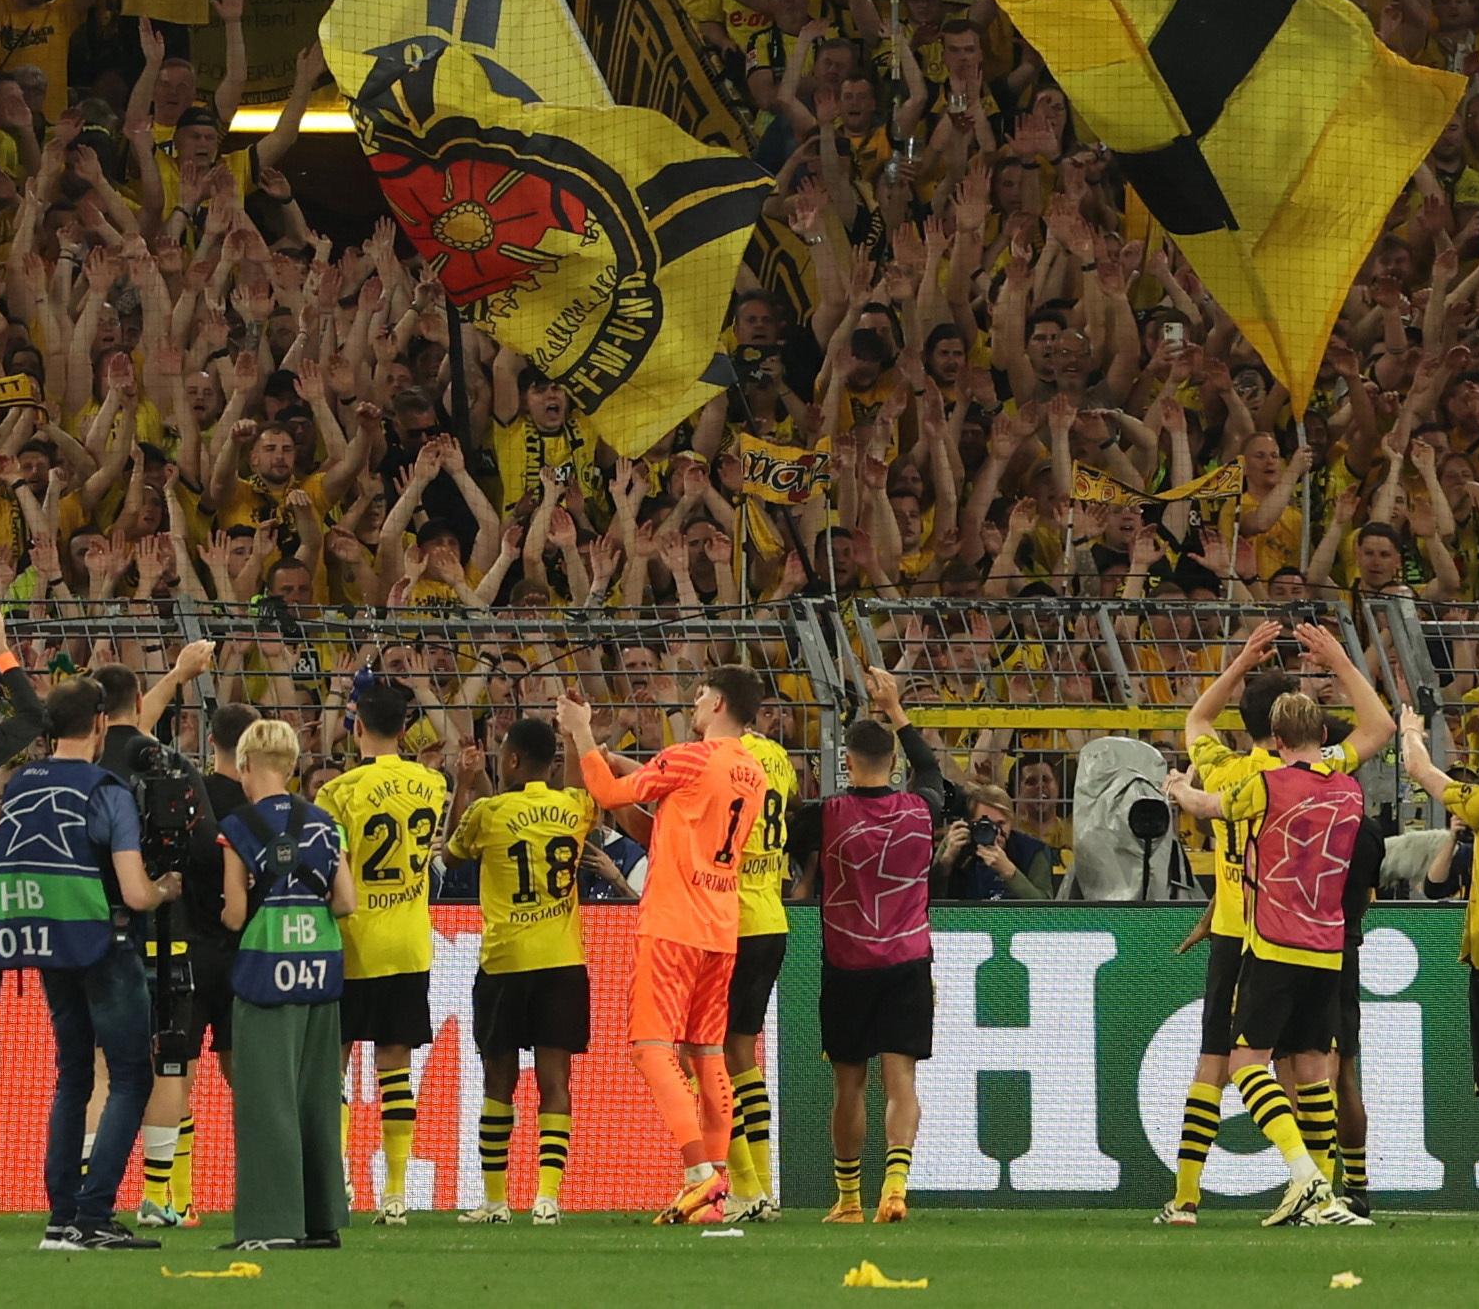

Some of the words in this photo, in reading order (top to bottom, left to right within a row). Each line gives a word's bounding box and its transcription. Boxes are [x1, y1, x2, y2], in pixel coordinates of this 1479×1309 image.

[367, 782, 402, 809] EMRE
[406, 779, 434, 804] CAN
[729, 766, 763, 794] KOBEL
[506, 805, 580, 835] MOUKOKO
[713, 797, 746, 870] 1
[763, 788, 785, 852] 8
[362, 807, 438, 886] 23
[507, 835, 580, 907] 18
[0, 880, 45, 912] HB
[282, 913, 318, 945] HB
[274, 959, 327, 992] 047
